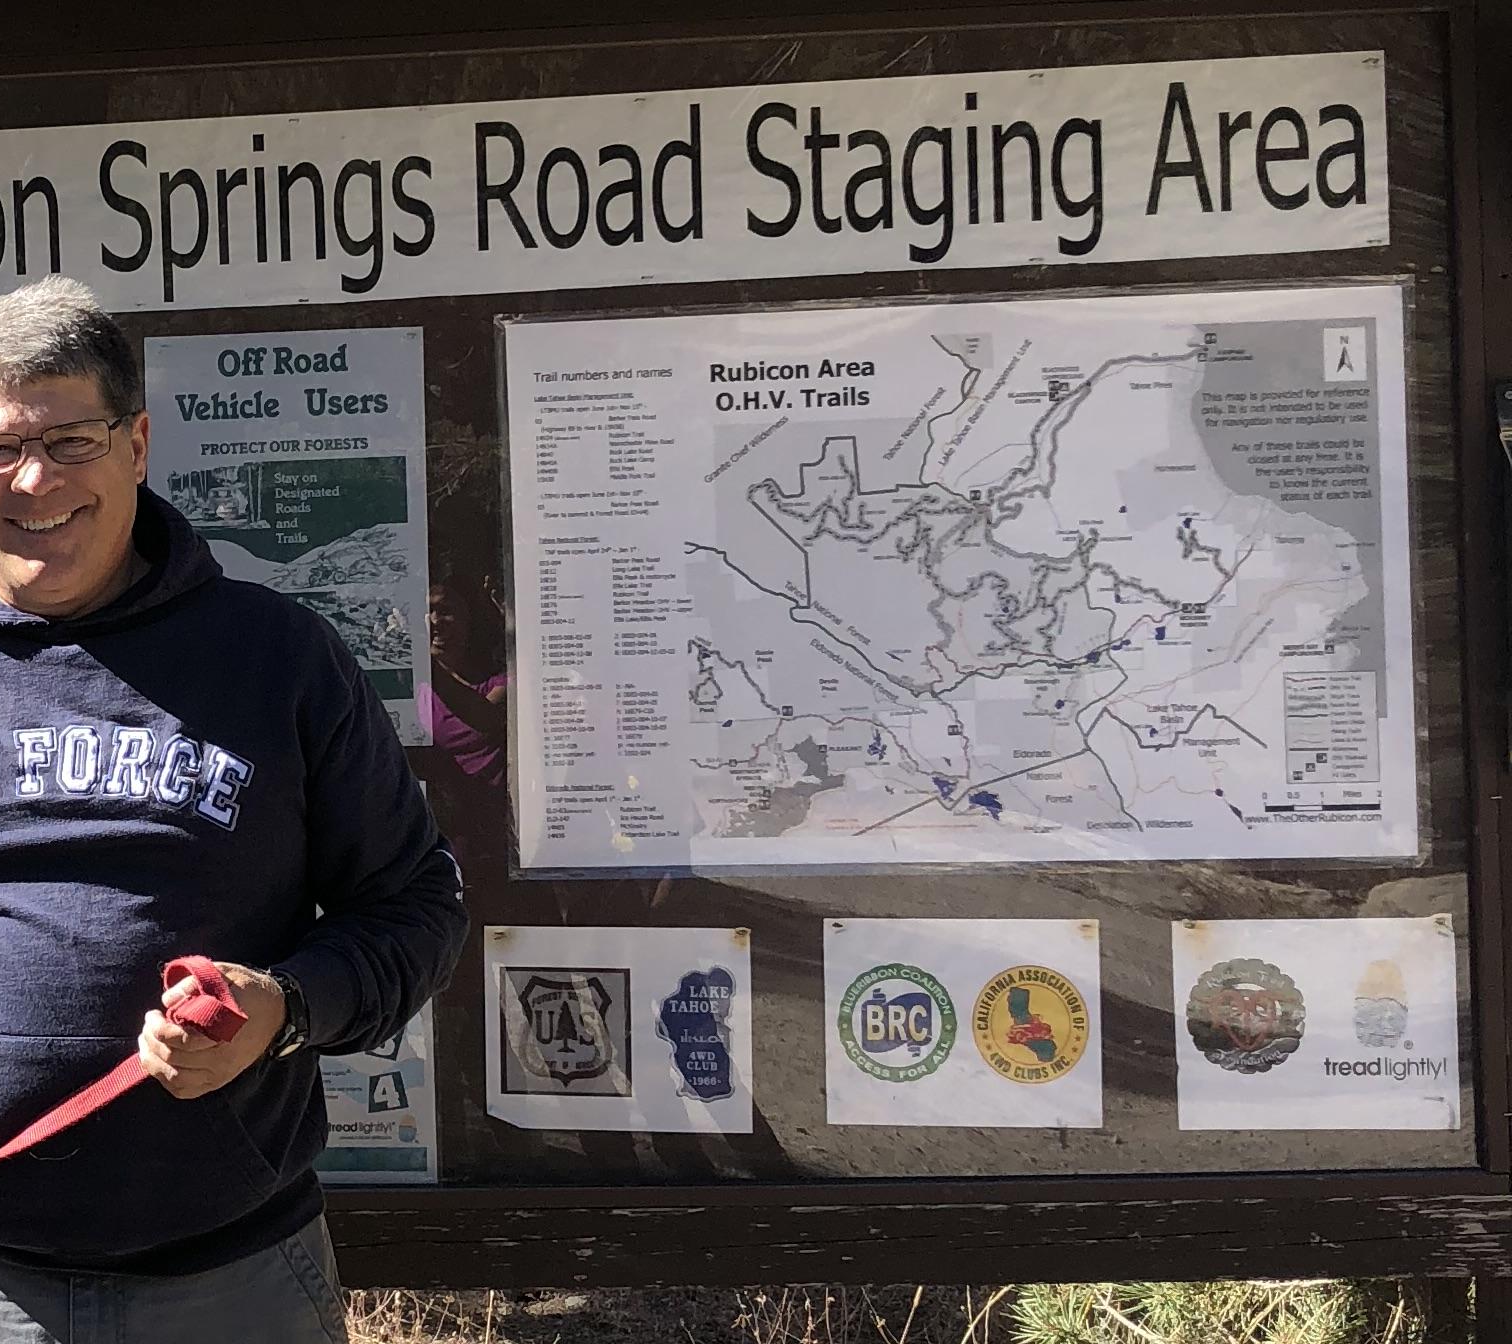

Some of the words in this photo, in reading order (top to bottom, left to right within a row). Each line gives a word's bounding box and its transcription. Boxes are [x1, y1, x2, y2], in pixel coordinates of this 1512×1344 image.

[99, 134, 434, 302] Springs
[475, 104, 703, 251] Road
[746, 92, 1103, 263] Staging
[1144, 82, 1368, 215] Area
[1340, 336, 1349, 344] N
[218, 347, 267, 376] Off
[273, 344, 348, 375] Road
[534, 372, 557, 382] Trail
[562, 370, 608, 381] numbers
[612, 369, 632, 379] and
[637, 368, 672, 378] names
[710, 361, 809, 382] Rubicon
[818, 359, 875, 378] Area
[716, 390, 792, 411] O.H.V.
[800, 387, 870, 408] Trails
[1202, 392, 1222, 402] This
[1225, 393, 1247, 402] map
[1249, 391, 1258, 400] is
[1260, 390, 1303, 402] provided
[1306, 389, 1320, 399] for
[1323, 387, 1370, 397] reference
[175, 391, 280, 421] Vehicle
[304, 388, 389, 416] Users
[1250, 404, 1266, 413] not
[1270, 402, 1312, 412] intended
[1315, 401, 1325, 411] to
[1329, 401, 1341, 410] be
[1344, 400, 1368, 409] used
[1205, 418, 1218, 427] for
[1222, 416, 1272, 428] navigation
[1295, 413, 1346, 425] regulatory
[201, 441, 267, 455] PROTECT
[270, 440, 300, 453] OUR
[304, 438, 368, 451] FORESTS
[704, 461, 730, 483] Granite
[749, 416, 788, 447] Wilderness
[1232, 443, 1249, 452] Any
[1253, 441, 1263, 451] of
[1266, 441, 1293, 450] these
[1296, 440, 1320, 450] trails
[1323, 439, 1350, 449] could
[1352, 439, 1365, 448] be
[1248, 454, 1279, 465] closed
[1295, 454, 1312, 464] any
[1306, 464, 1370, 475] responsibility
[274, 473, 300, 484] Stay
[302, 473, 317, 482] on
[1269, 480, 1281, 489] to
[1283, 479, 1309, 488] know
[1312, 478, 1330, 488] the
[275, 486, 340, 500] Designated
[1280, 492, 1310, 501] status
[1313, 491, 1323, 500] of
[1326, 490, 1350, 499] each
[276, 503, 312, 514] Roads
[276, 518, 299, 529] and
[276, 533, 308, 544] Trails
[812, 600, 842, 626] National
[810, 638, 844, 665] Eldorado
[1160, 715, 1184, 724] Basin
[1183, 737, 1240, 747] Management
[12, 724, 256, 832] FORCE
[1045, 794, 1073, 804] Forest
[1146, 820, 1193, 829] Wilderness
[1244, 813, 1382, 824] www.TheOtherRubicon.com
[690, 986, 729, 998] LAKE
[844, 968, 898, 1014] BLUERIBBON
[900, 968, 952, 1014] COALITION
[669, 1000, 719, 1014] TAHOE
[978, 974, 1016, 1031] CALIFORNIA
[1017, 969, 1084, 1018] ASSOCIATION
[1074, 1018, 1086, 1032] OF
[866, 1004, 928, 1042] BRC
[688, 1051, 716, 1062] 4WD
[844, 1040, 891, 1078] ACCESS
[899, 1064, 928, 1079] FOR
[932, 1040, 952, 1066] ALL
[686, 1061, 718, 1071] CLUB
[1013, 1067, 1049, 1080] CLUBS
